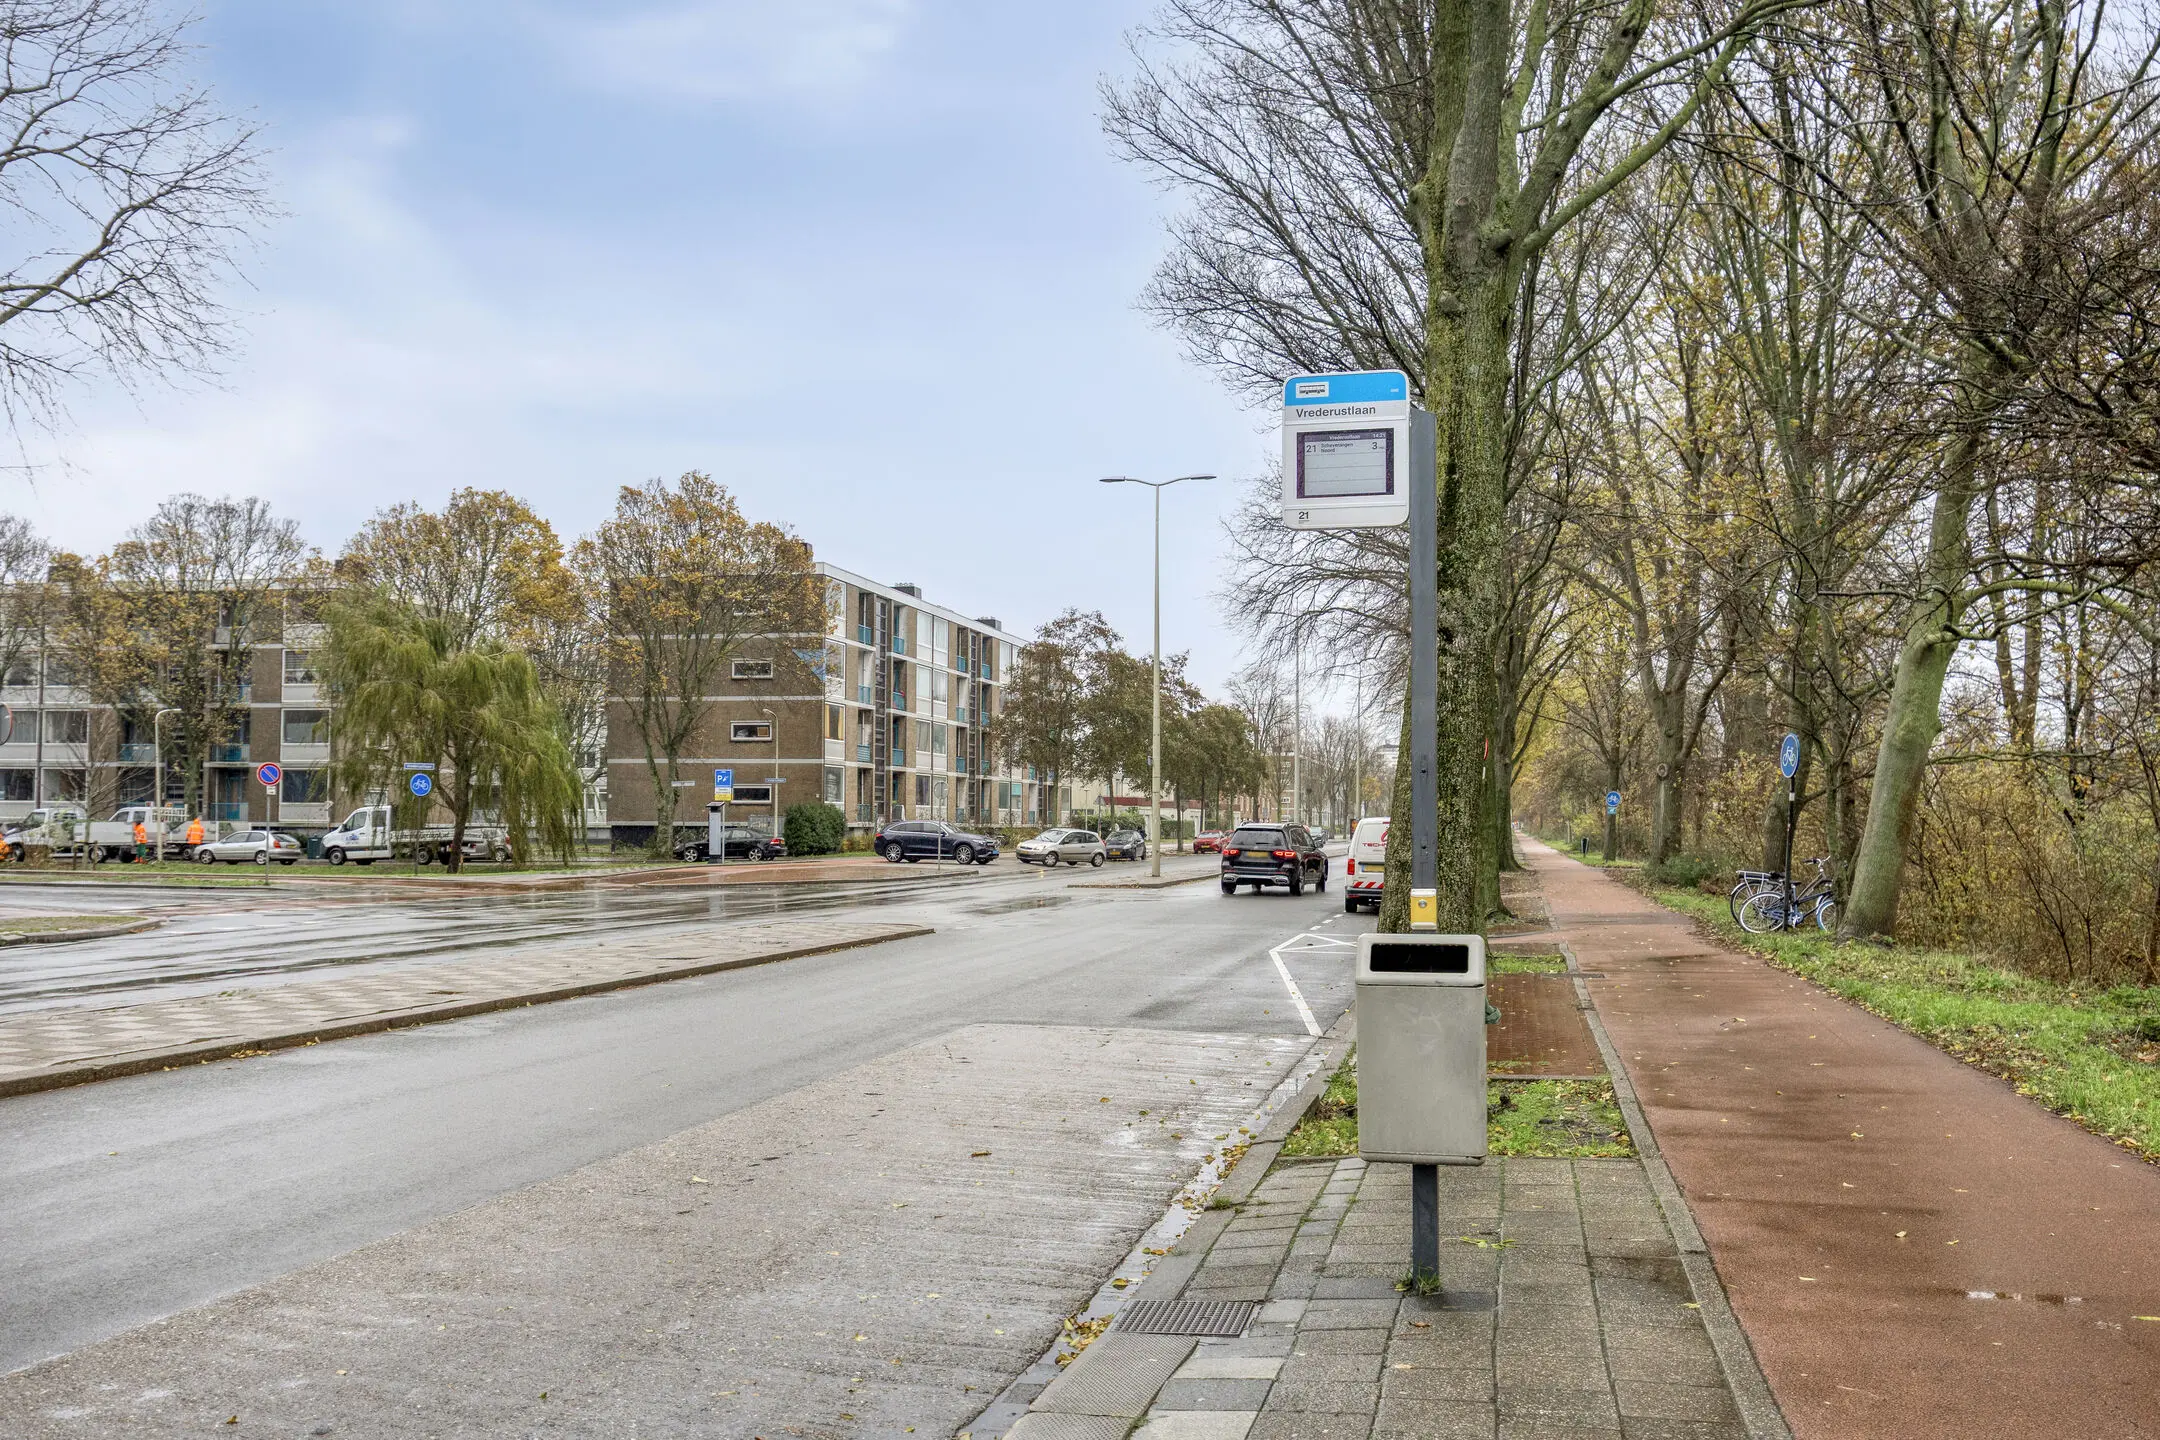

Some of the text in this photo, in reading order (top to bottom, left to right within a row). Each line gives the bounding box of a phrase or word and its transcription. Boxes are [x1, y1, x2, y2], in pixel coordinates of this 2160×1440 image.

[1296, 406, 1376, 418] Vrederustlaan
[1306, 444, 1317, 453] 21
[1372, 441, 1378, 450] 3
[1298, 511, 1309, 519] 21
